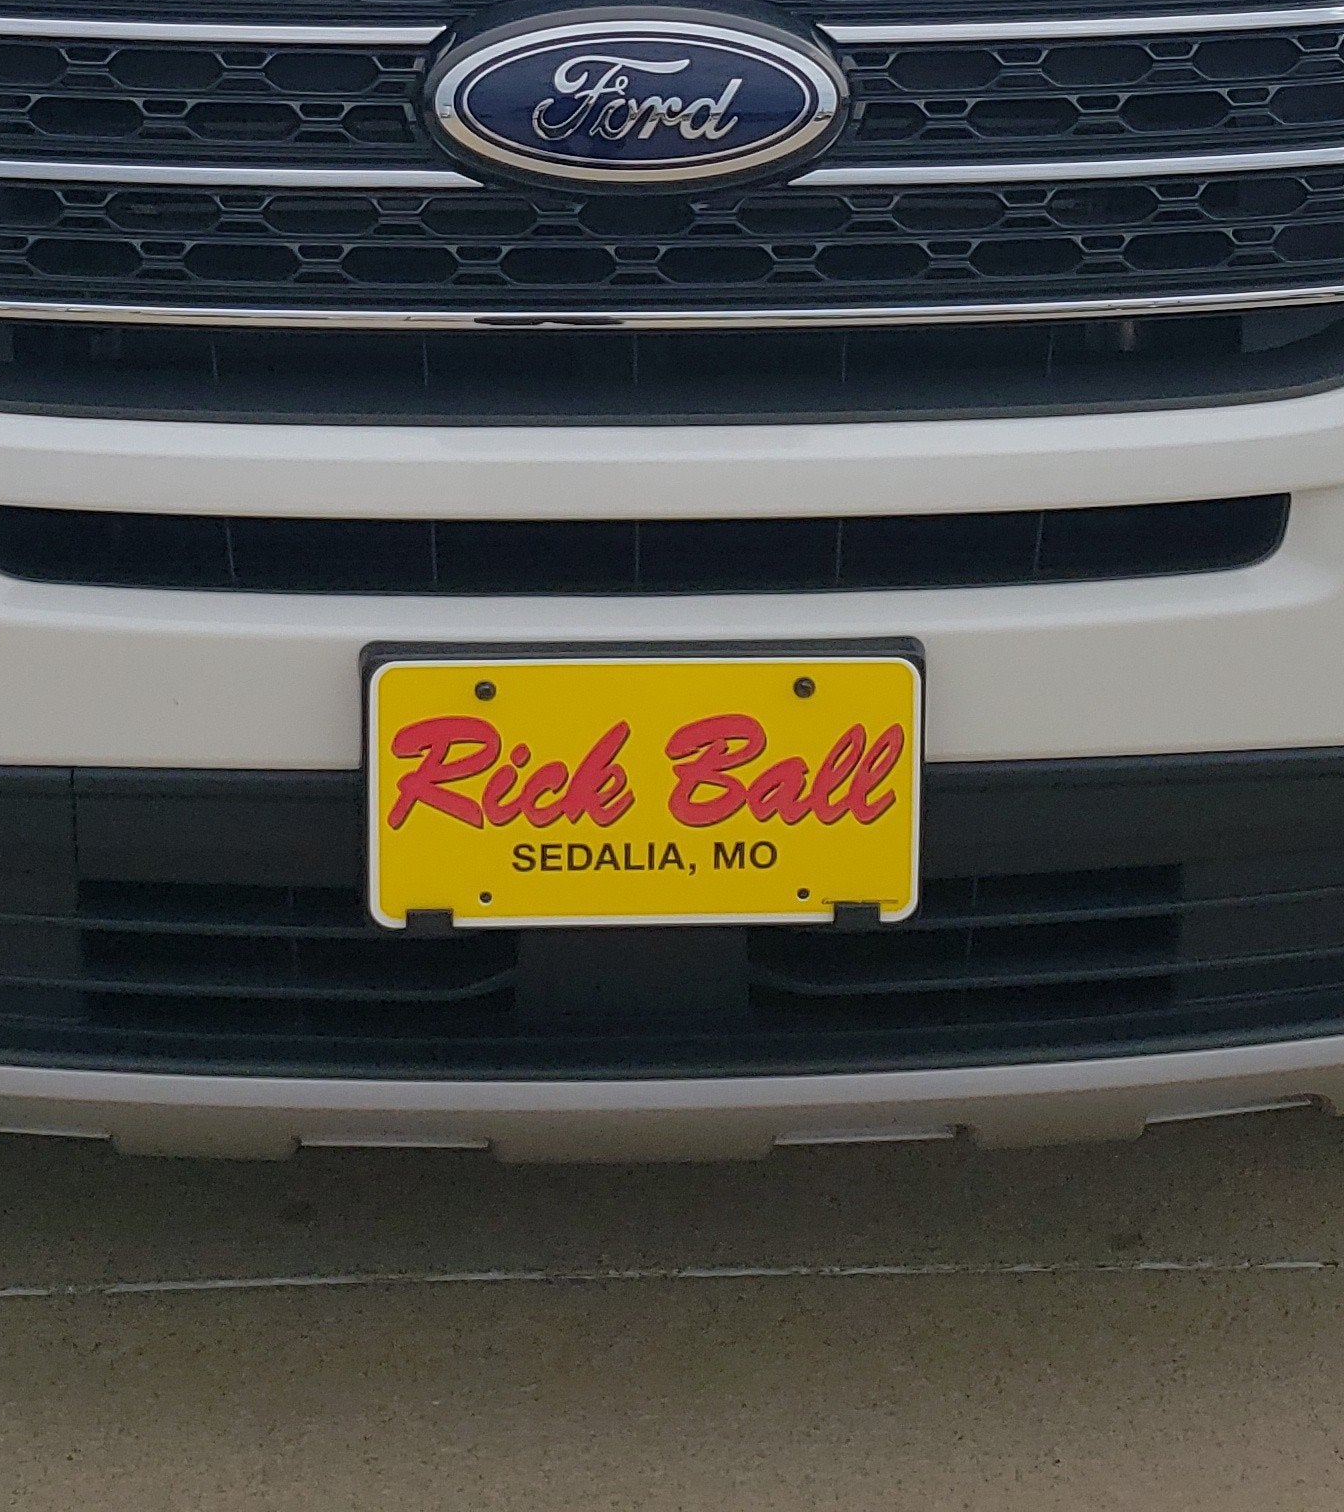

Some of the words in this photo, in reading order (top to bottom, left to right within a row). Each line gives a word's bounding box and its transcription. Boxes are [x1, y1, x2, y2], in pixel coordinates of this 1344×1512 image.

[531, 54, 743, 141] Ford
[387, 715, 636, 830] Rick
[664, 713, 905, 828] Ball
[511, 841, 697, 876] SEDALIA,
[713, 840, 778, 870] MO
